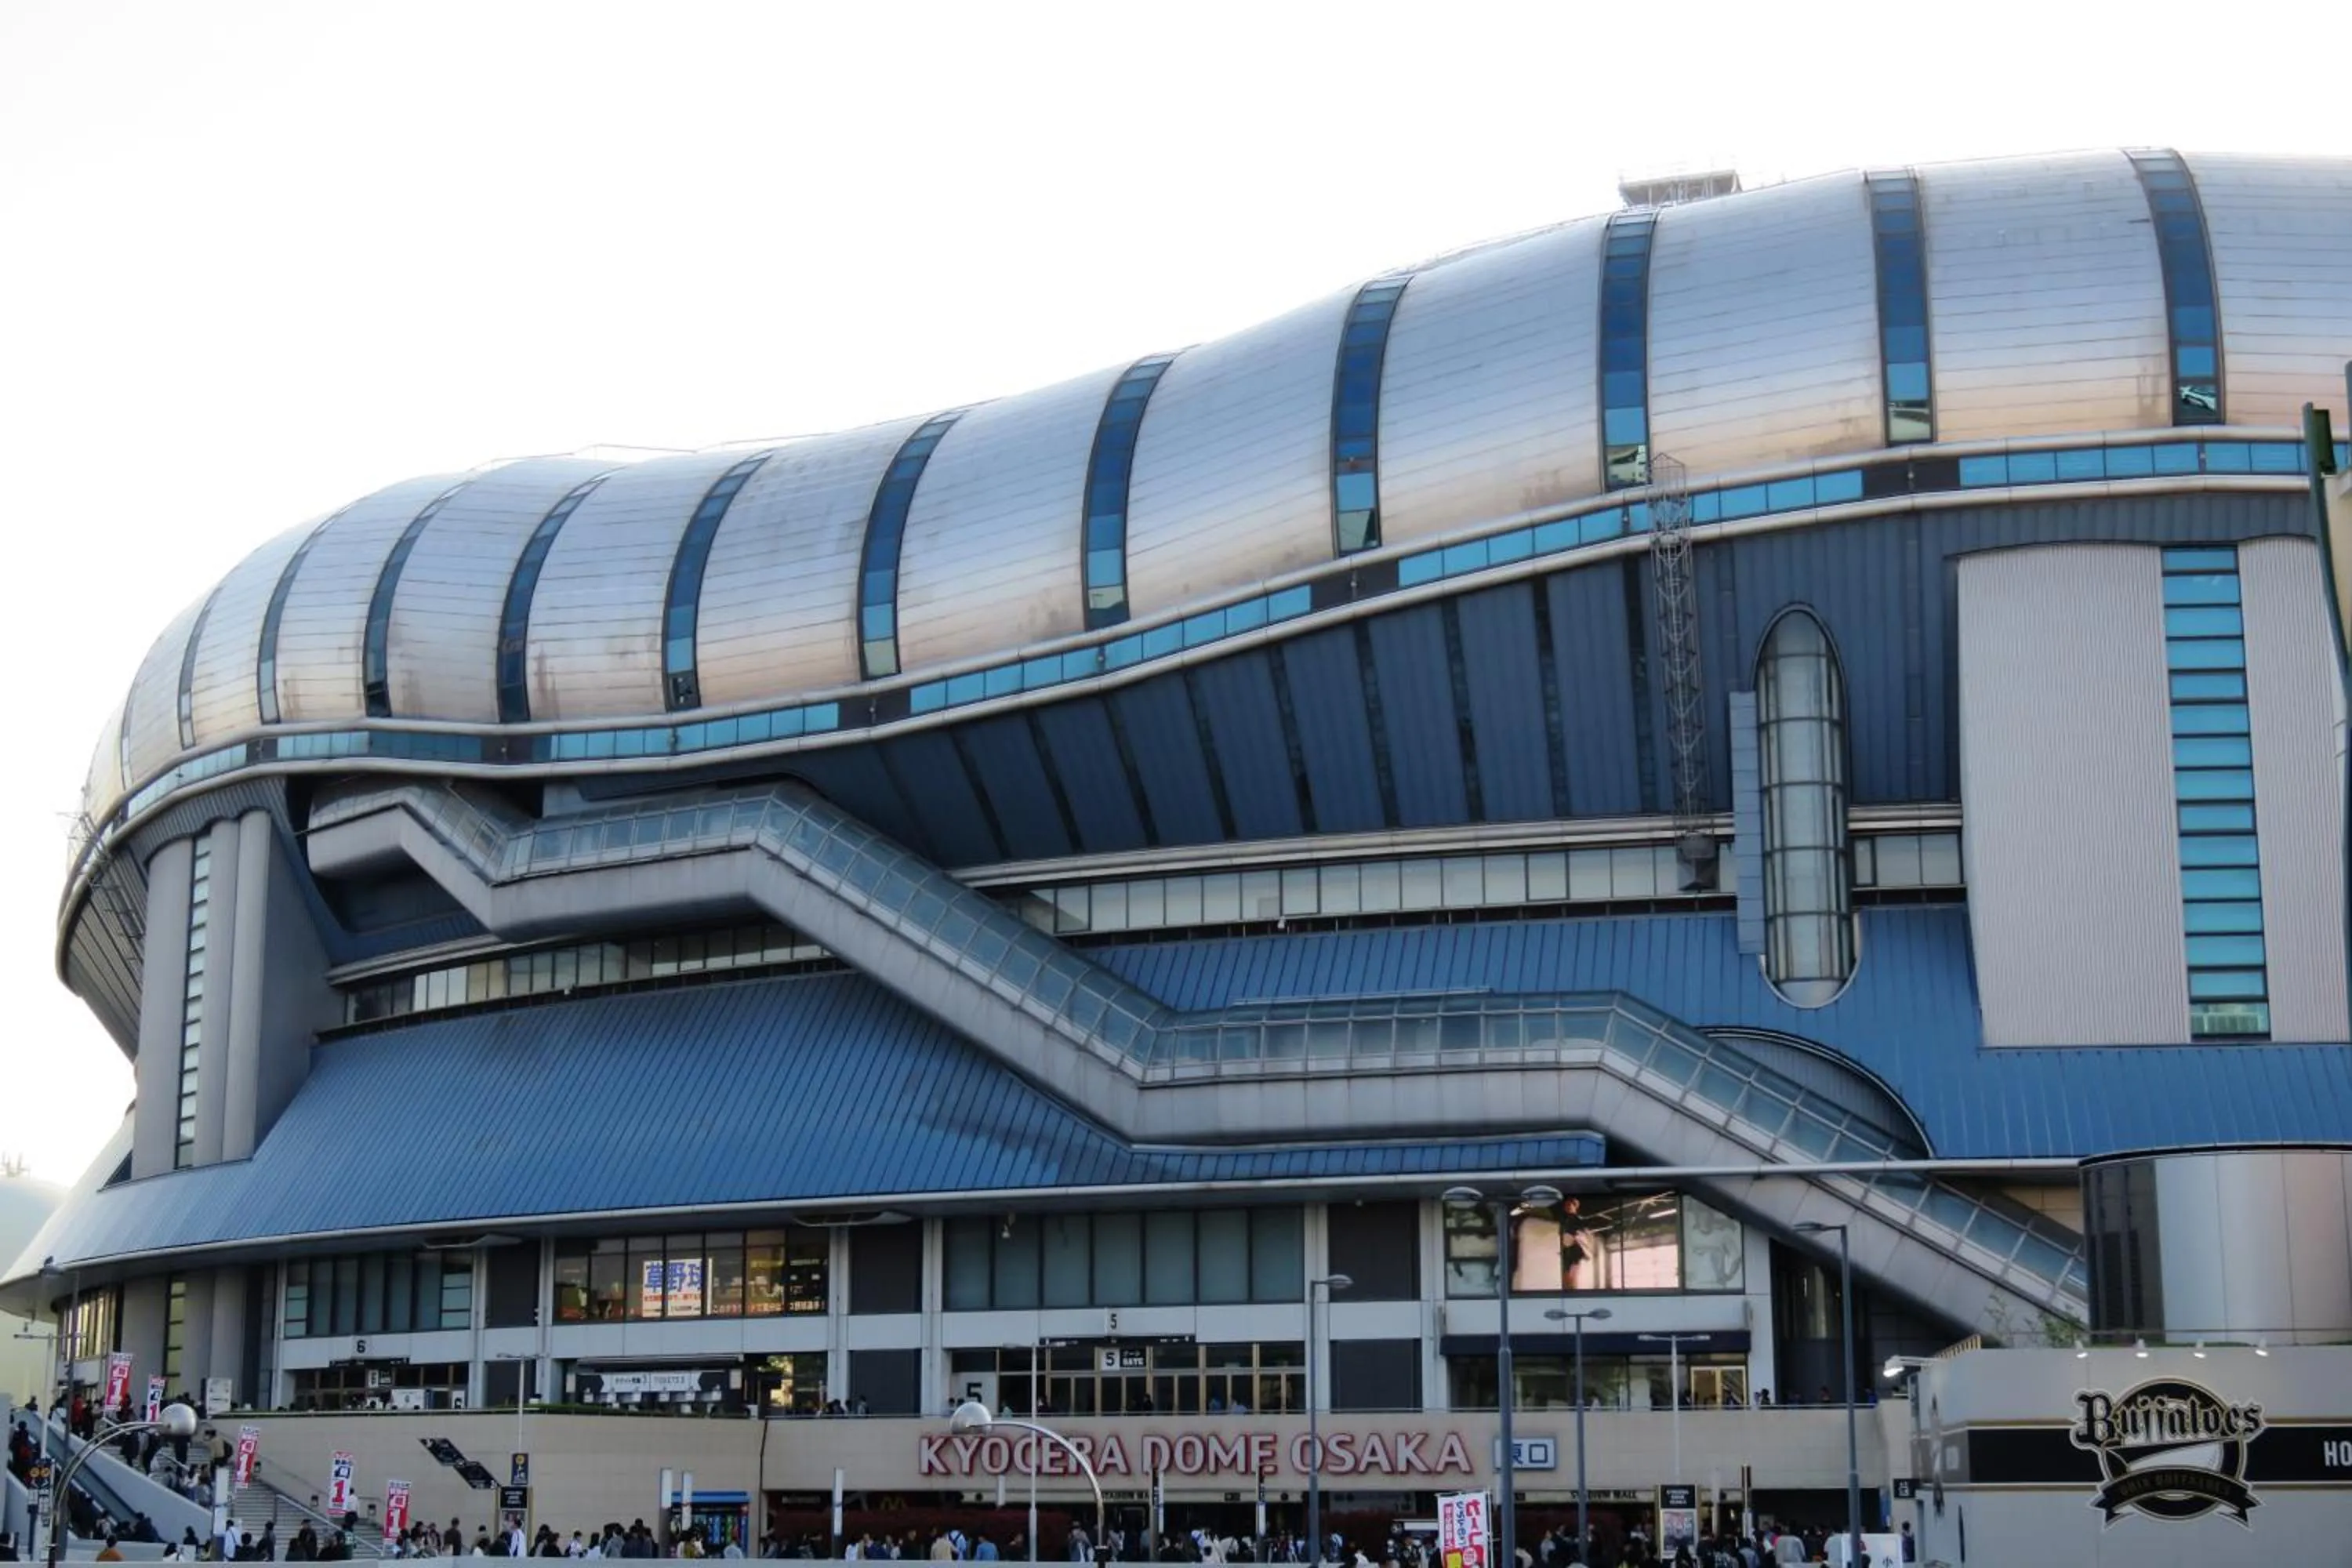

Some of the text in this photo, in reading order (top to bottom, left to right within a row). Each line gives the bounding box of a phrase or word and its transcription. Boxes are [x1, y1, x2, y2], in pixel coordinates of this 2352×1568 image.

[1110, 1313, 1118, 1330] 5
[357, 1339, 366, 1353] 6
[1105, 1352, 1116, 1367] 5
[1122, 1357, 1145, 1367] GATE
[2074, 1392, 2263, 1446] Buffaloes
[920, 1432, 1473, 1475] KYOCERA DOME OSAKA
[2323, 1440, 2352, 1467] HO
[332, 1479, 346, 1503] 1
